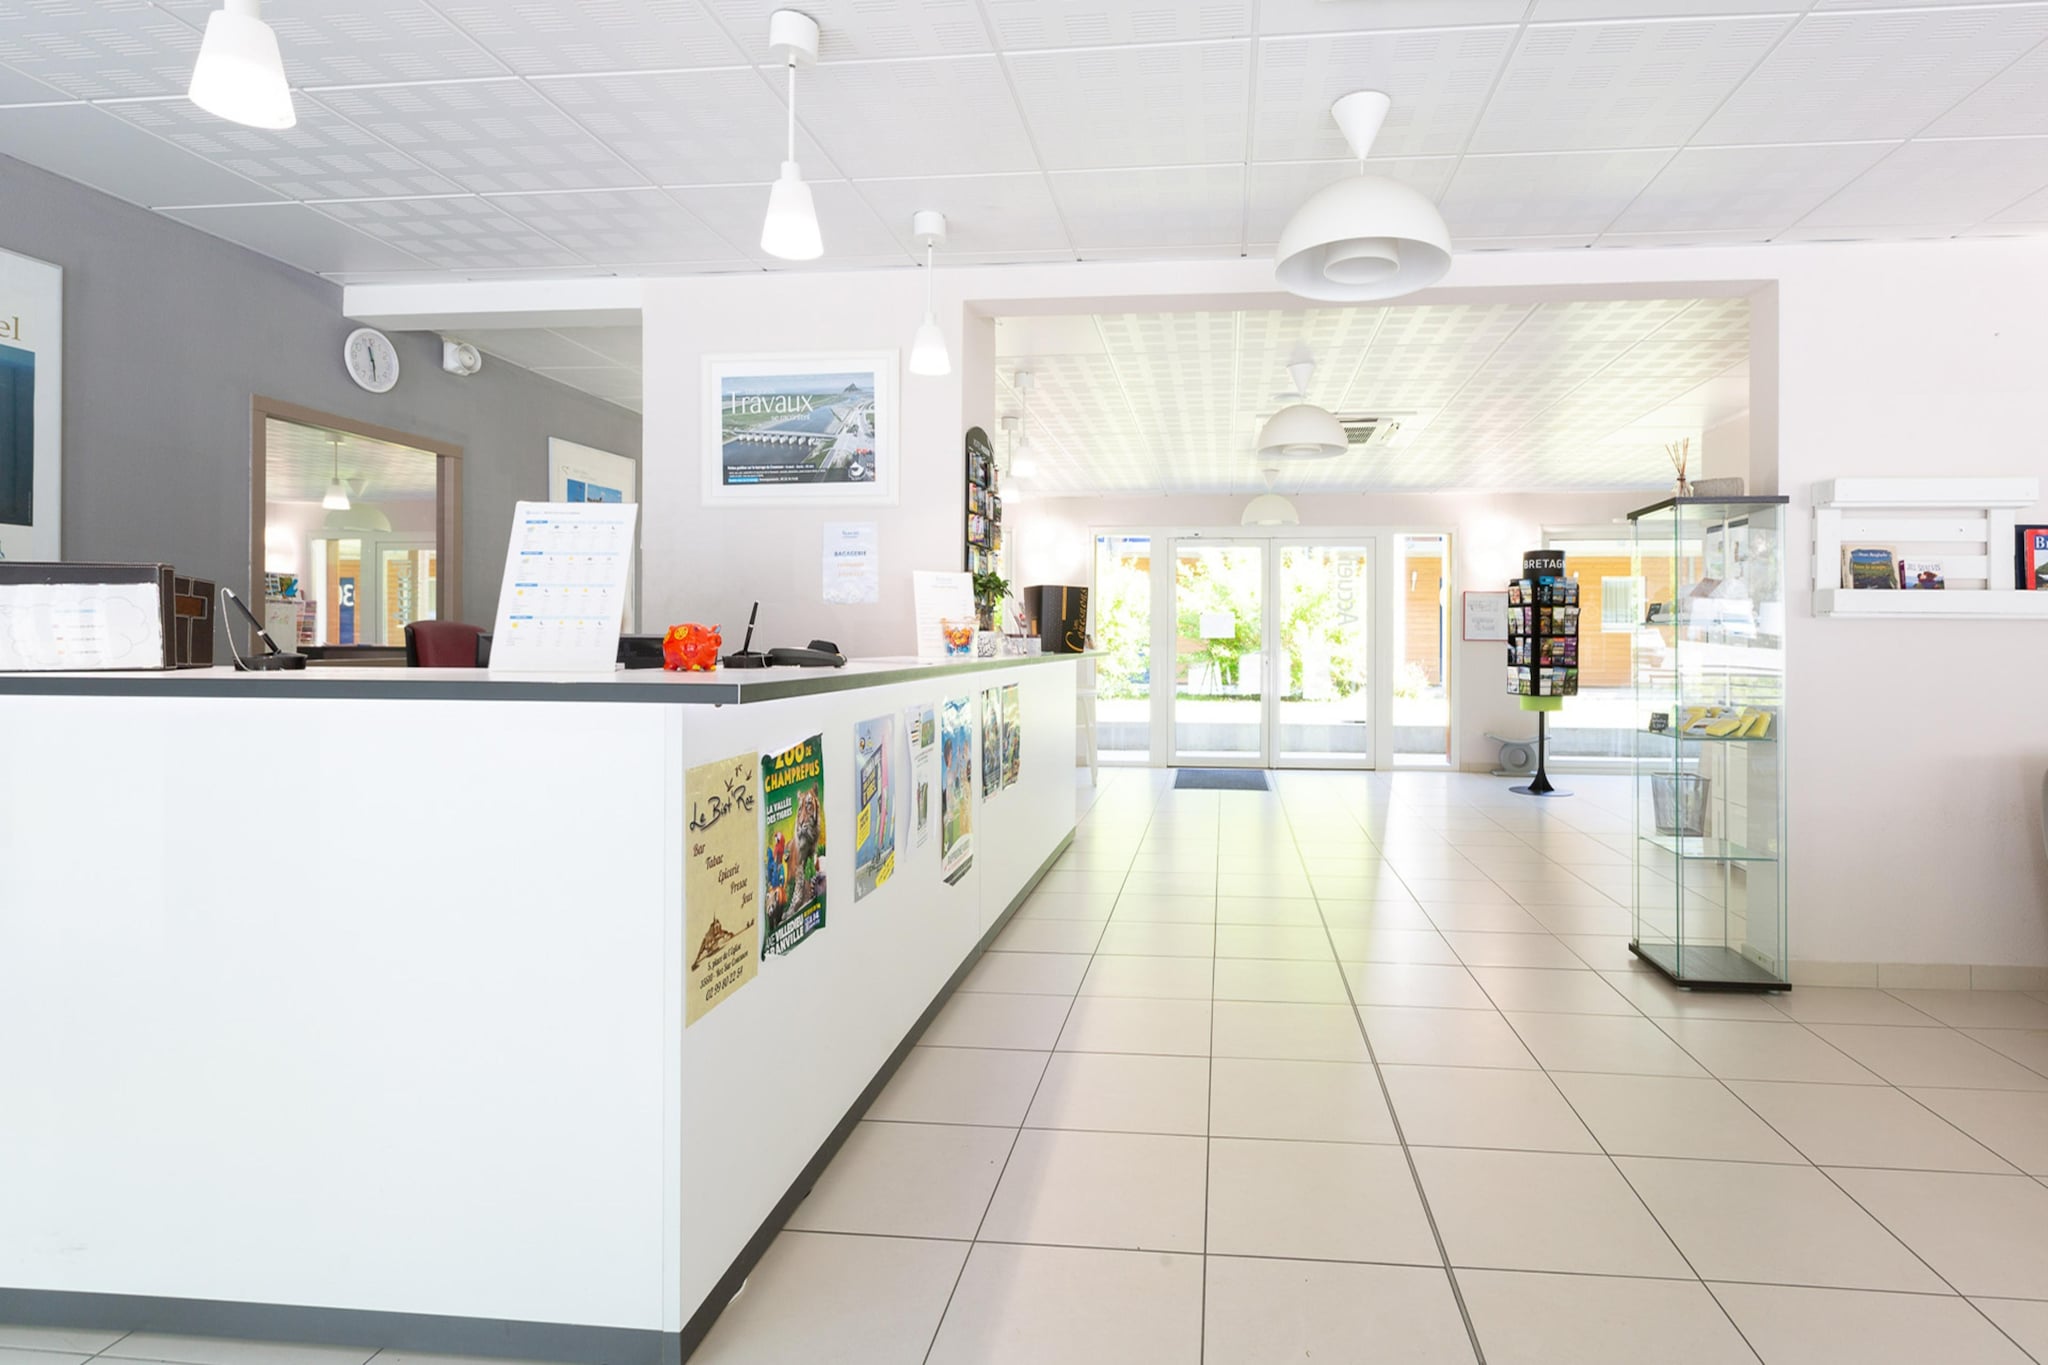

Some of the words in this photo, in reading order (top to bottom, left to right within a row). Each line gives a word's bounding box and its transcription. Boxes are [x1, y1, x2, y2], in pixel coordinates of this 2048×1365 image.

[726, 391, 814, 415] Travaux
[775, 742, 805, 769] ZOO
[764, 759, 820, 793] CHAMPREPUS
[766, 805, 774, 815] LA
[773, 796, 792, 812] VALLÉE
[767, 813, 776, 825] DES
[776, 807, 793, 820] TIGRES
[690, 801, 706, 832] Le
[693, 838, 706, 857] Bar
[706, 854, 724, 871] Tabac
